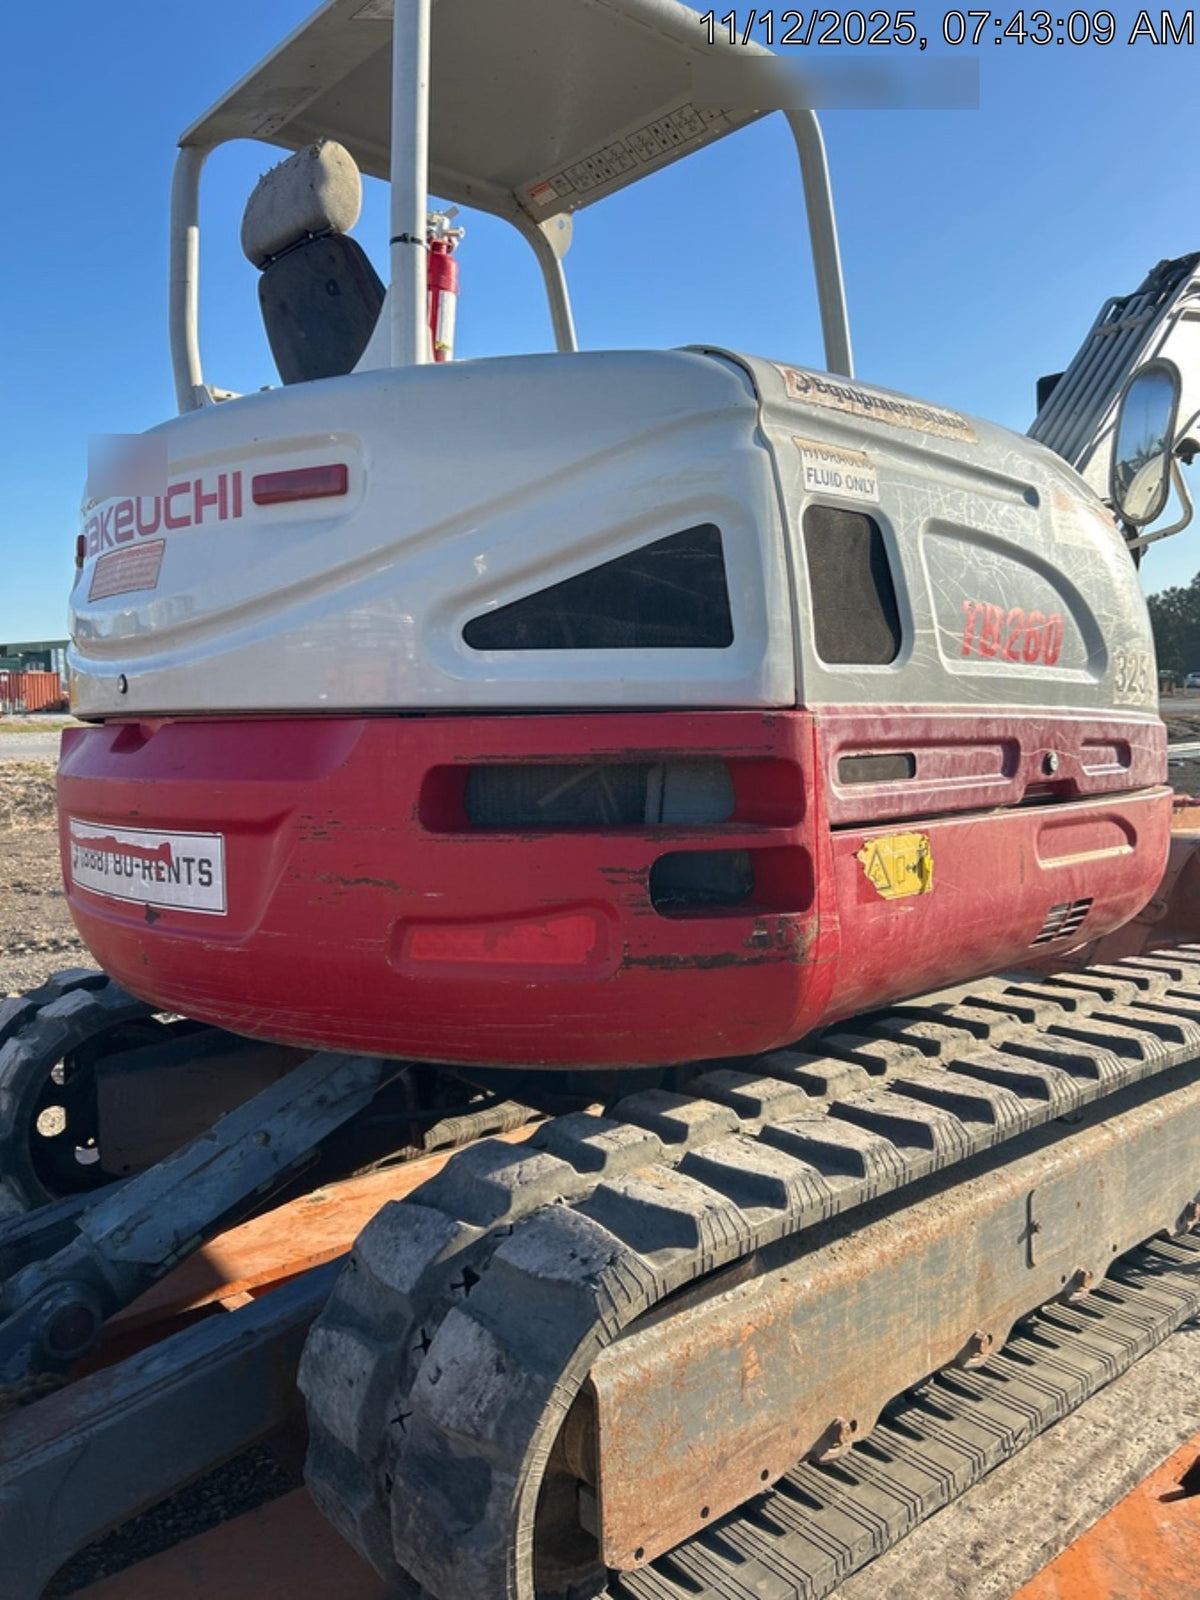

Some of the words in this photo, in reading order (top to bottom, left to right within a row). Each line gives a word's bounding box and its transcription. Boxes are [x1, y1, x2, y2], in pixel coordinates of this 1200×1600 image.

[806, 467, 842, 488] FLUID
[846, 474, 875, 494] ONLY
[960, 600, 1064, 666] TB260
